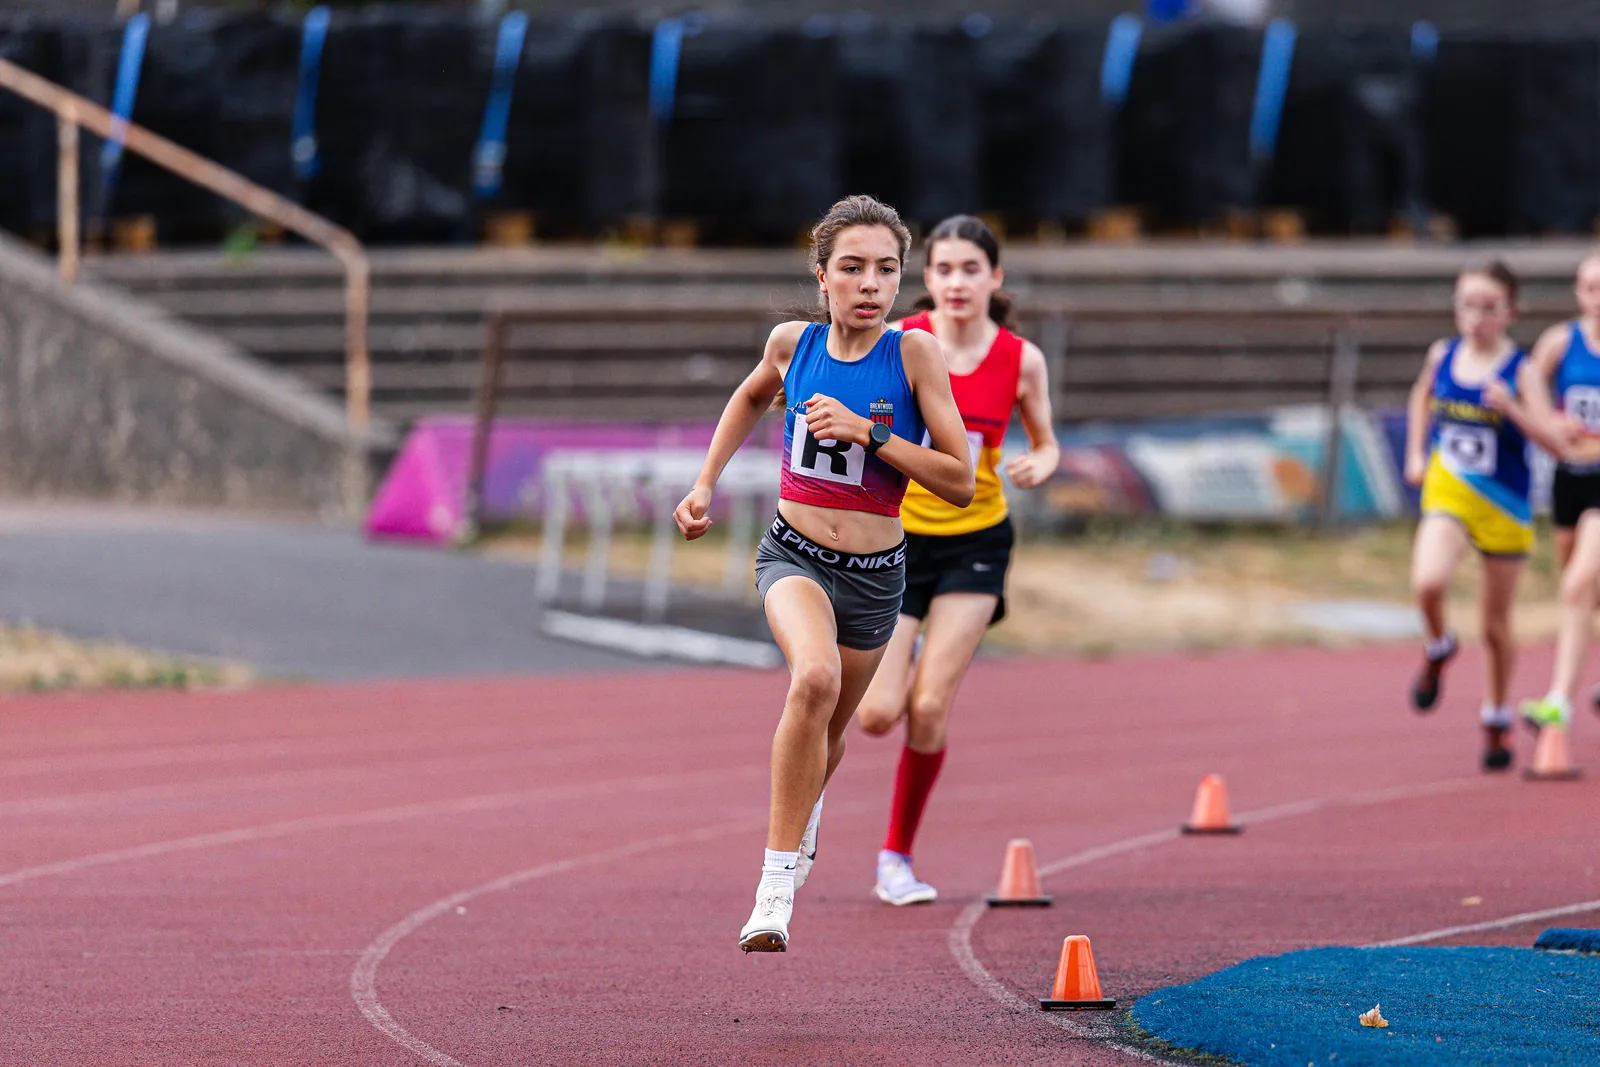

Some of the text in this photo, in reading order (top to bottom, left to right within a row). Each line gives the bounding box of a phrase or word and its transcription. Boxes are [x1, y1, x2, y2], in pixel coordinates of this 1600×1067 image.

[801, 424, 853, 477] R
[781, 528, 841, 564] PRO
[846, 544, 905, 570] NIKE
